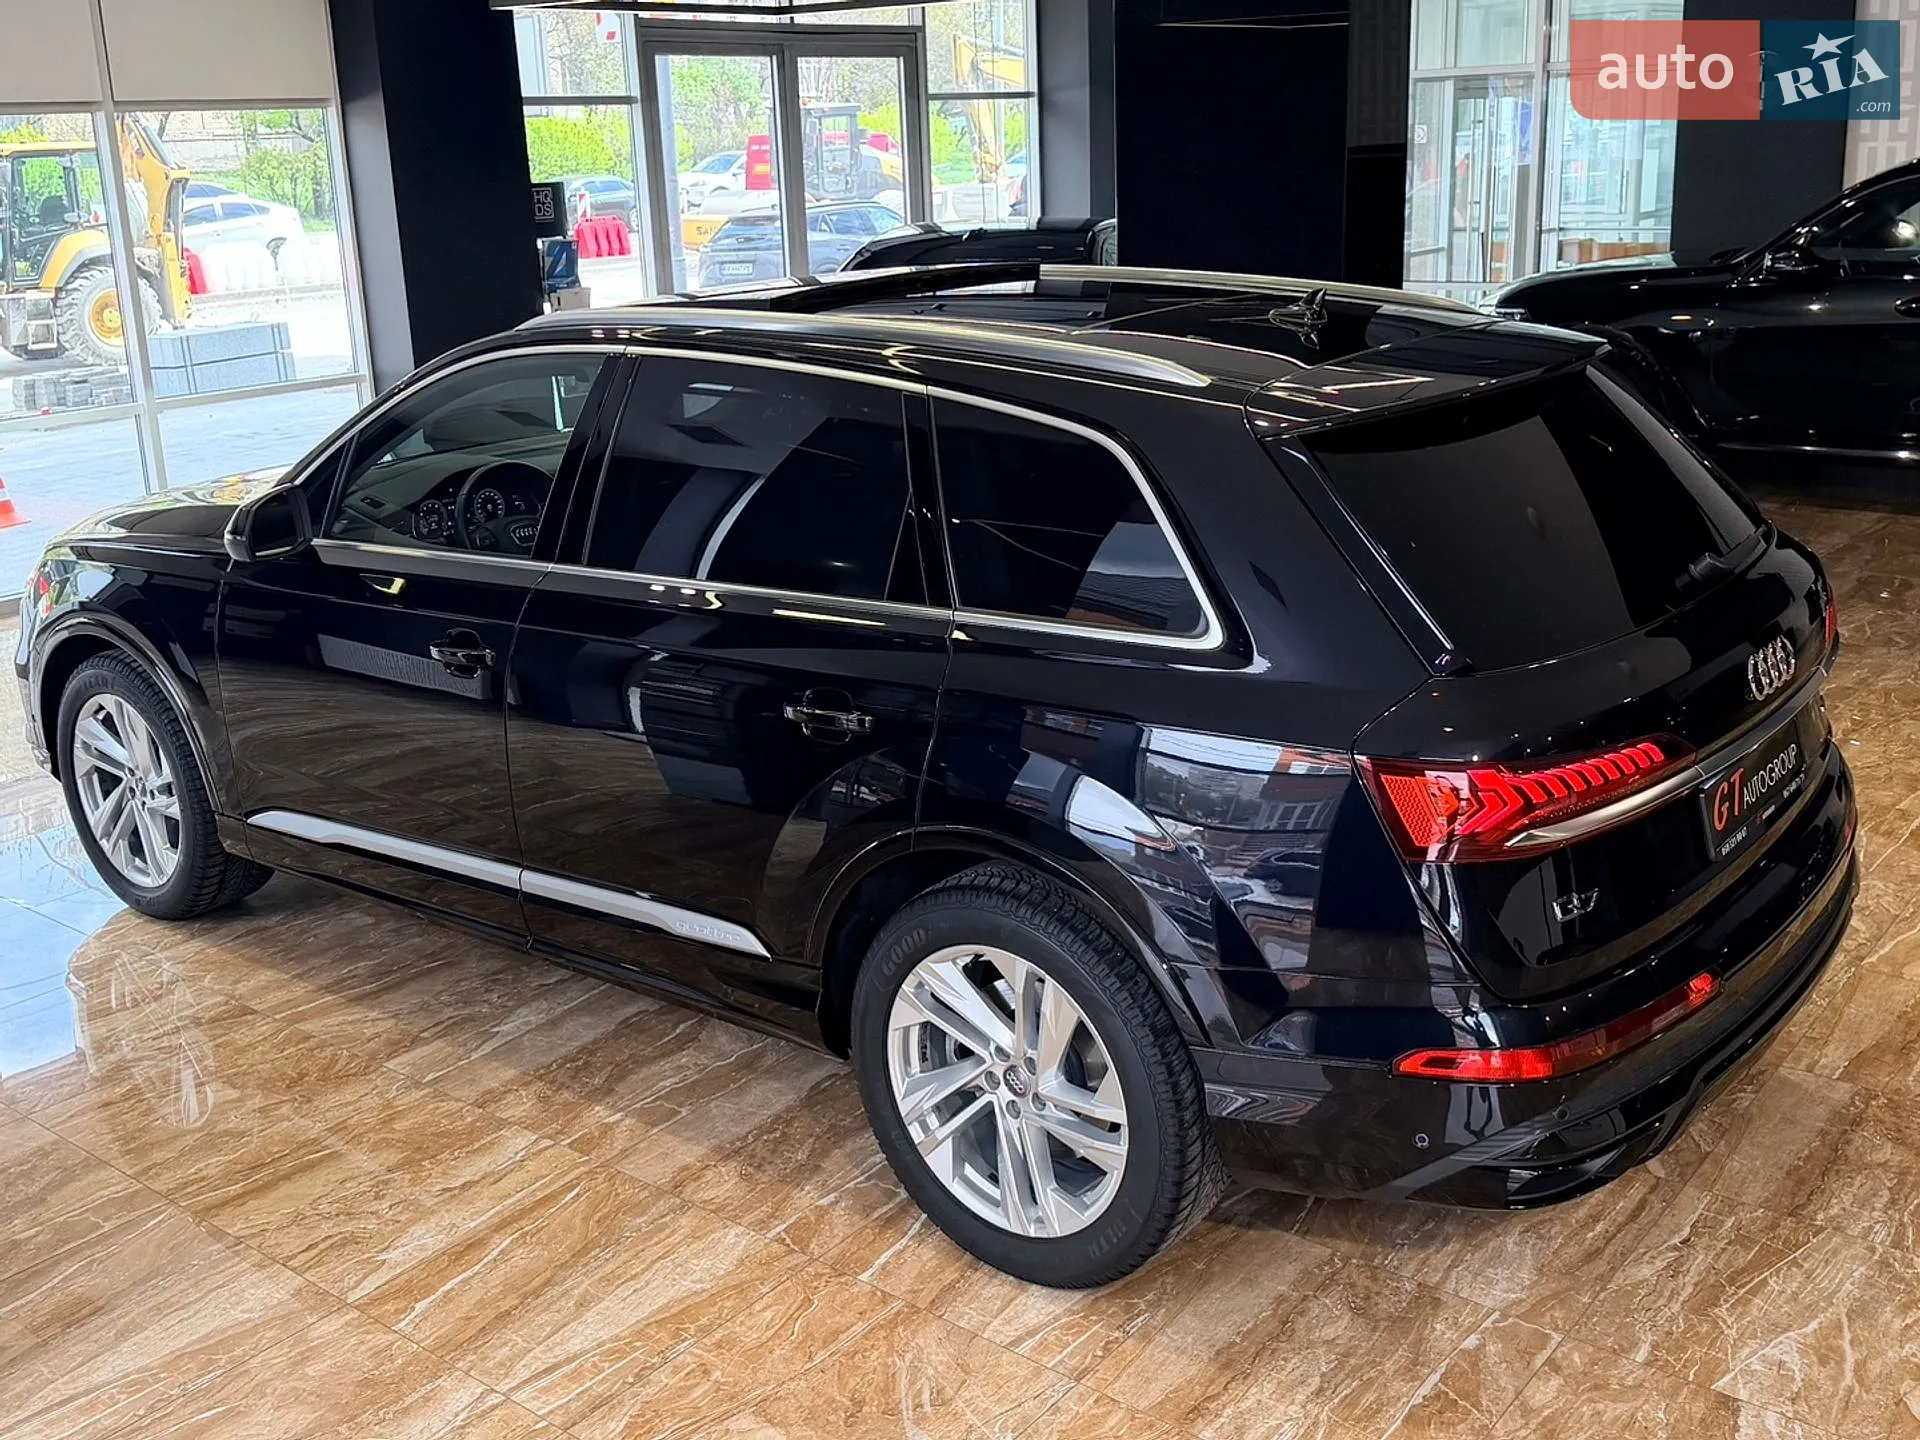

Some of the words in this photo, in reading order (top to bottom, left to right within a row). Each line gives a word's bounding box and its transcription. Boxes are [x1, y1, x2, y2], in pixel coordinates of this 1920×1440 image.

[1713, 767, 1744, 831] GT
[1743, 743, 1797, 809] AUTOGROUP
[1552, 888, 1599, 922] Q7
